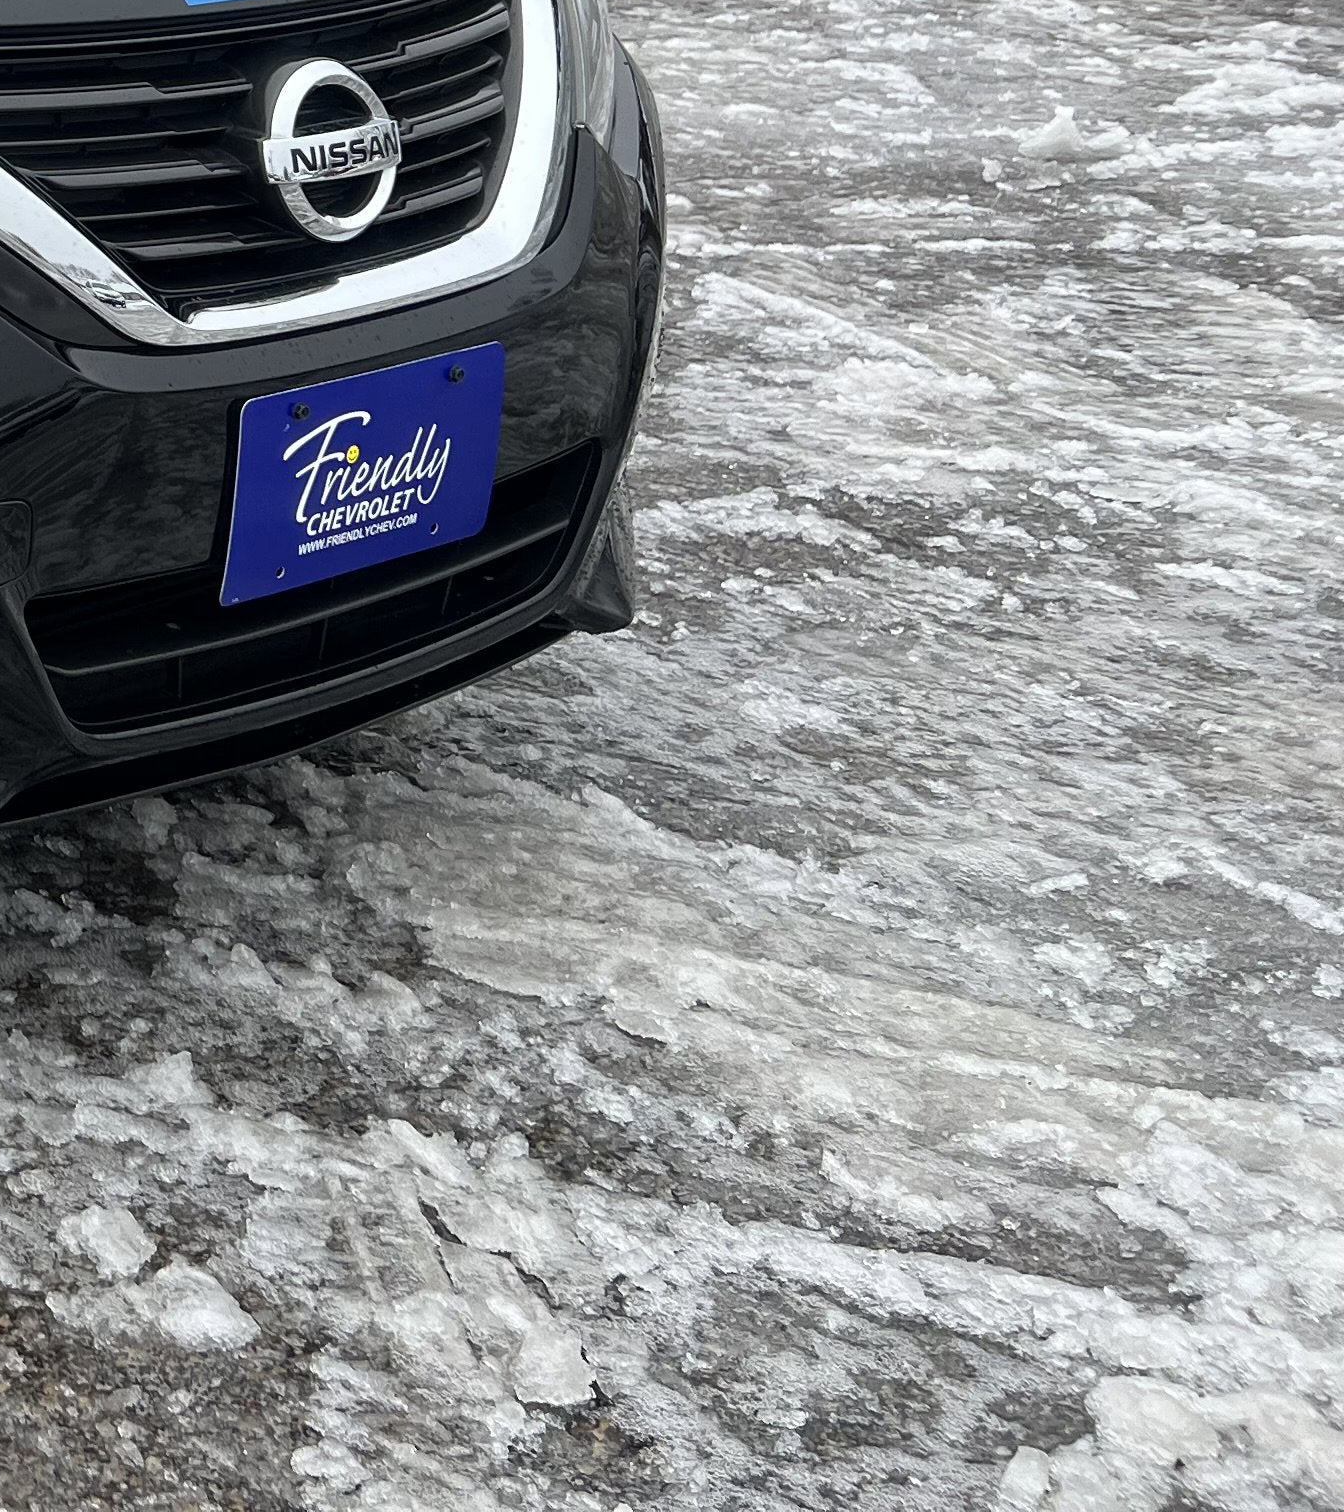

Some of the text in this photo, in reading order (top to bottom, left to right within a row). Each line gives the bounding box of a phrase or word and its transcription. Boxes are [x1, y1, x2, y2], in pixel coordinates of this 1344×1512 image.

[290, 121, 399, 174] NISSAN
[283, 410, 451, 524] Friendly
[297, 512, 418, 556] WWW.FRIENDLYCHEV.COM
[306, 486, 416, 536] CHEVROLET
